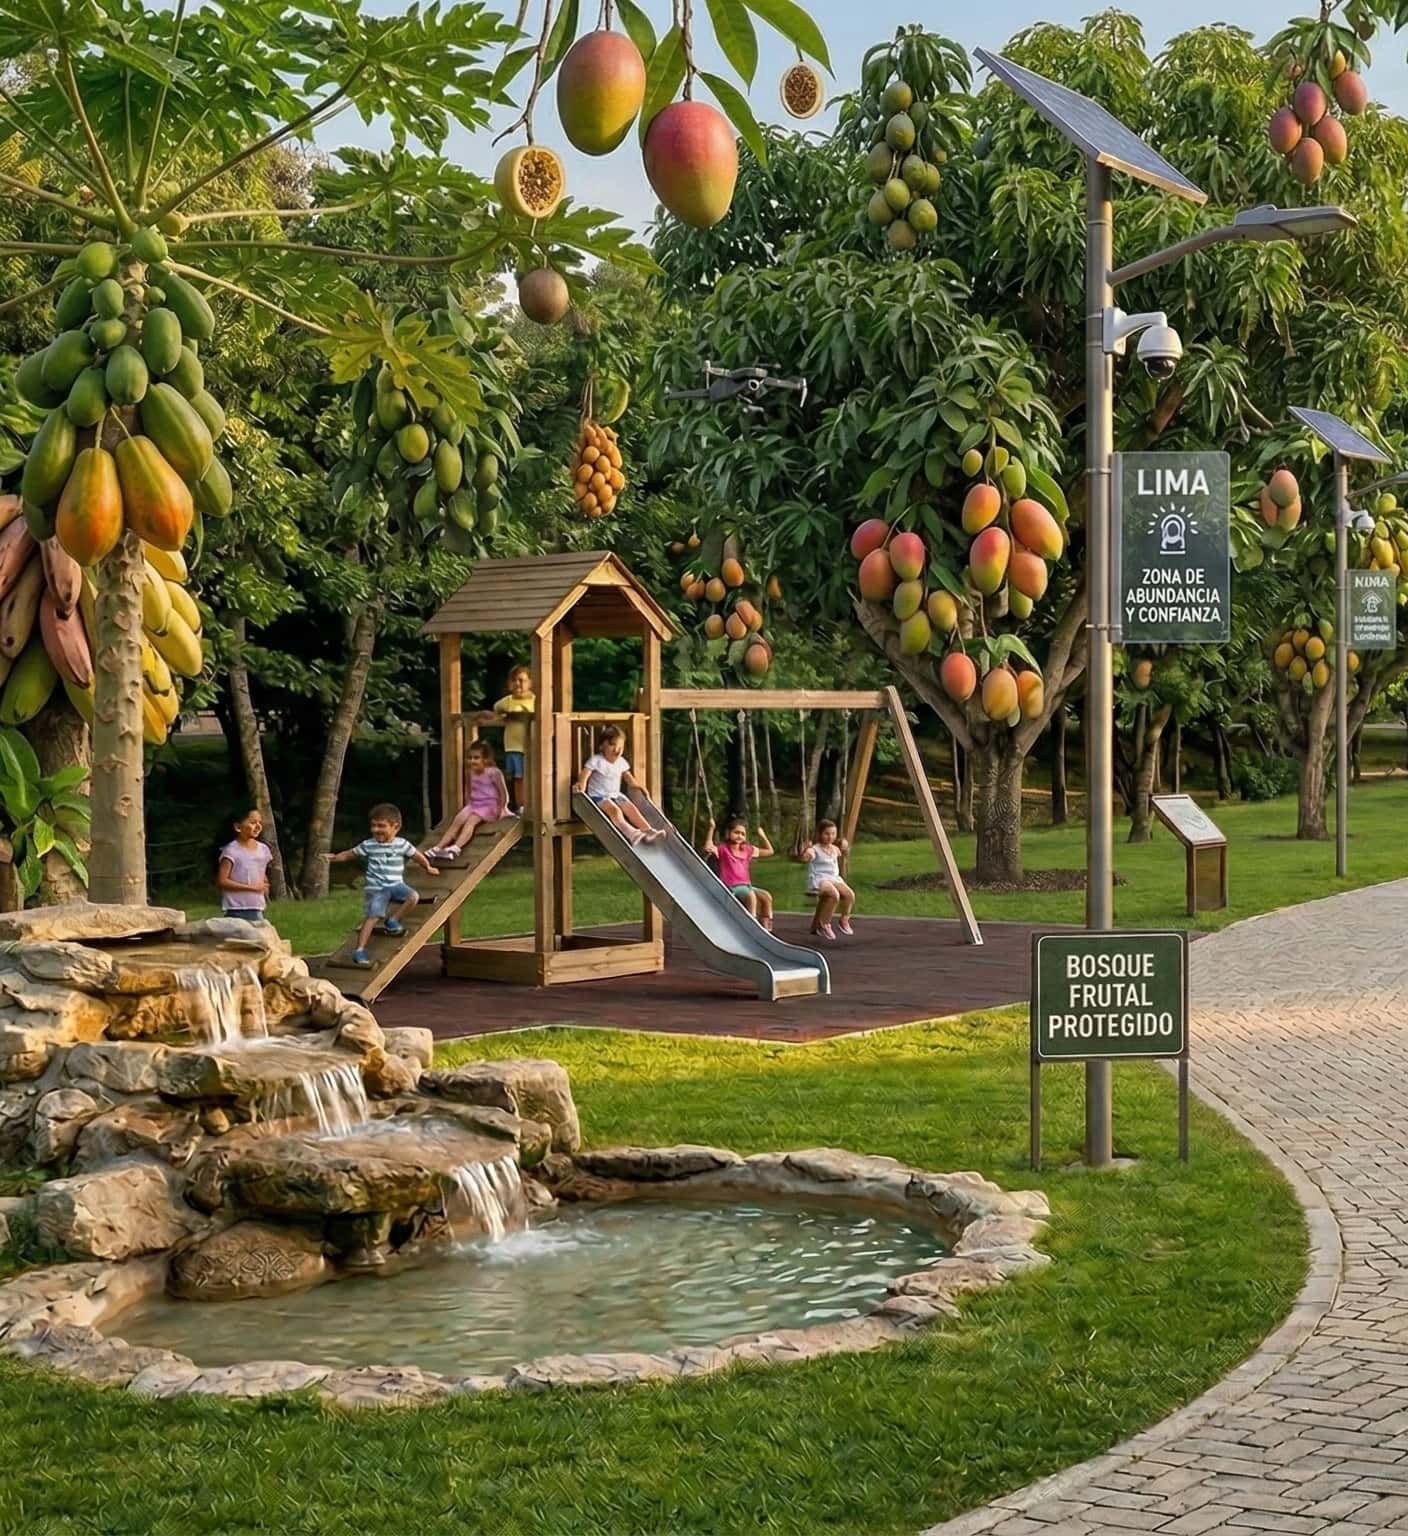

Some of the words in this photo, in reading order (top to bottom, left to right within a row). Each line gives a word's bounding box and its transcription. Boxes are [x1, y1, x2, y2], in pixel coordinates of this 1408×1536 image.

[1137, 469, 1210, 495] LIMA
[1142, 568, 1182, 585] ZONA
[1185, 568, 1205, 585] DE
[1126, 588, 1220, 604] ABUNDANCIA
[1125, 607, 1135, 623] Y
[1138, 607, 1221, 623] CONFIANZA
[1066, 953, 1155, 978] BOSQUE
[1069, 983, 1154, 1008] FRUTAL
[1048, 1012, 1173, 1039] PROTEGIDO
